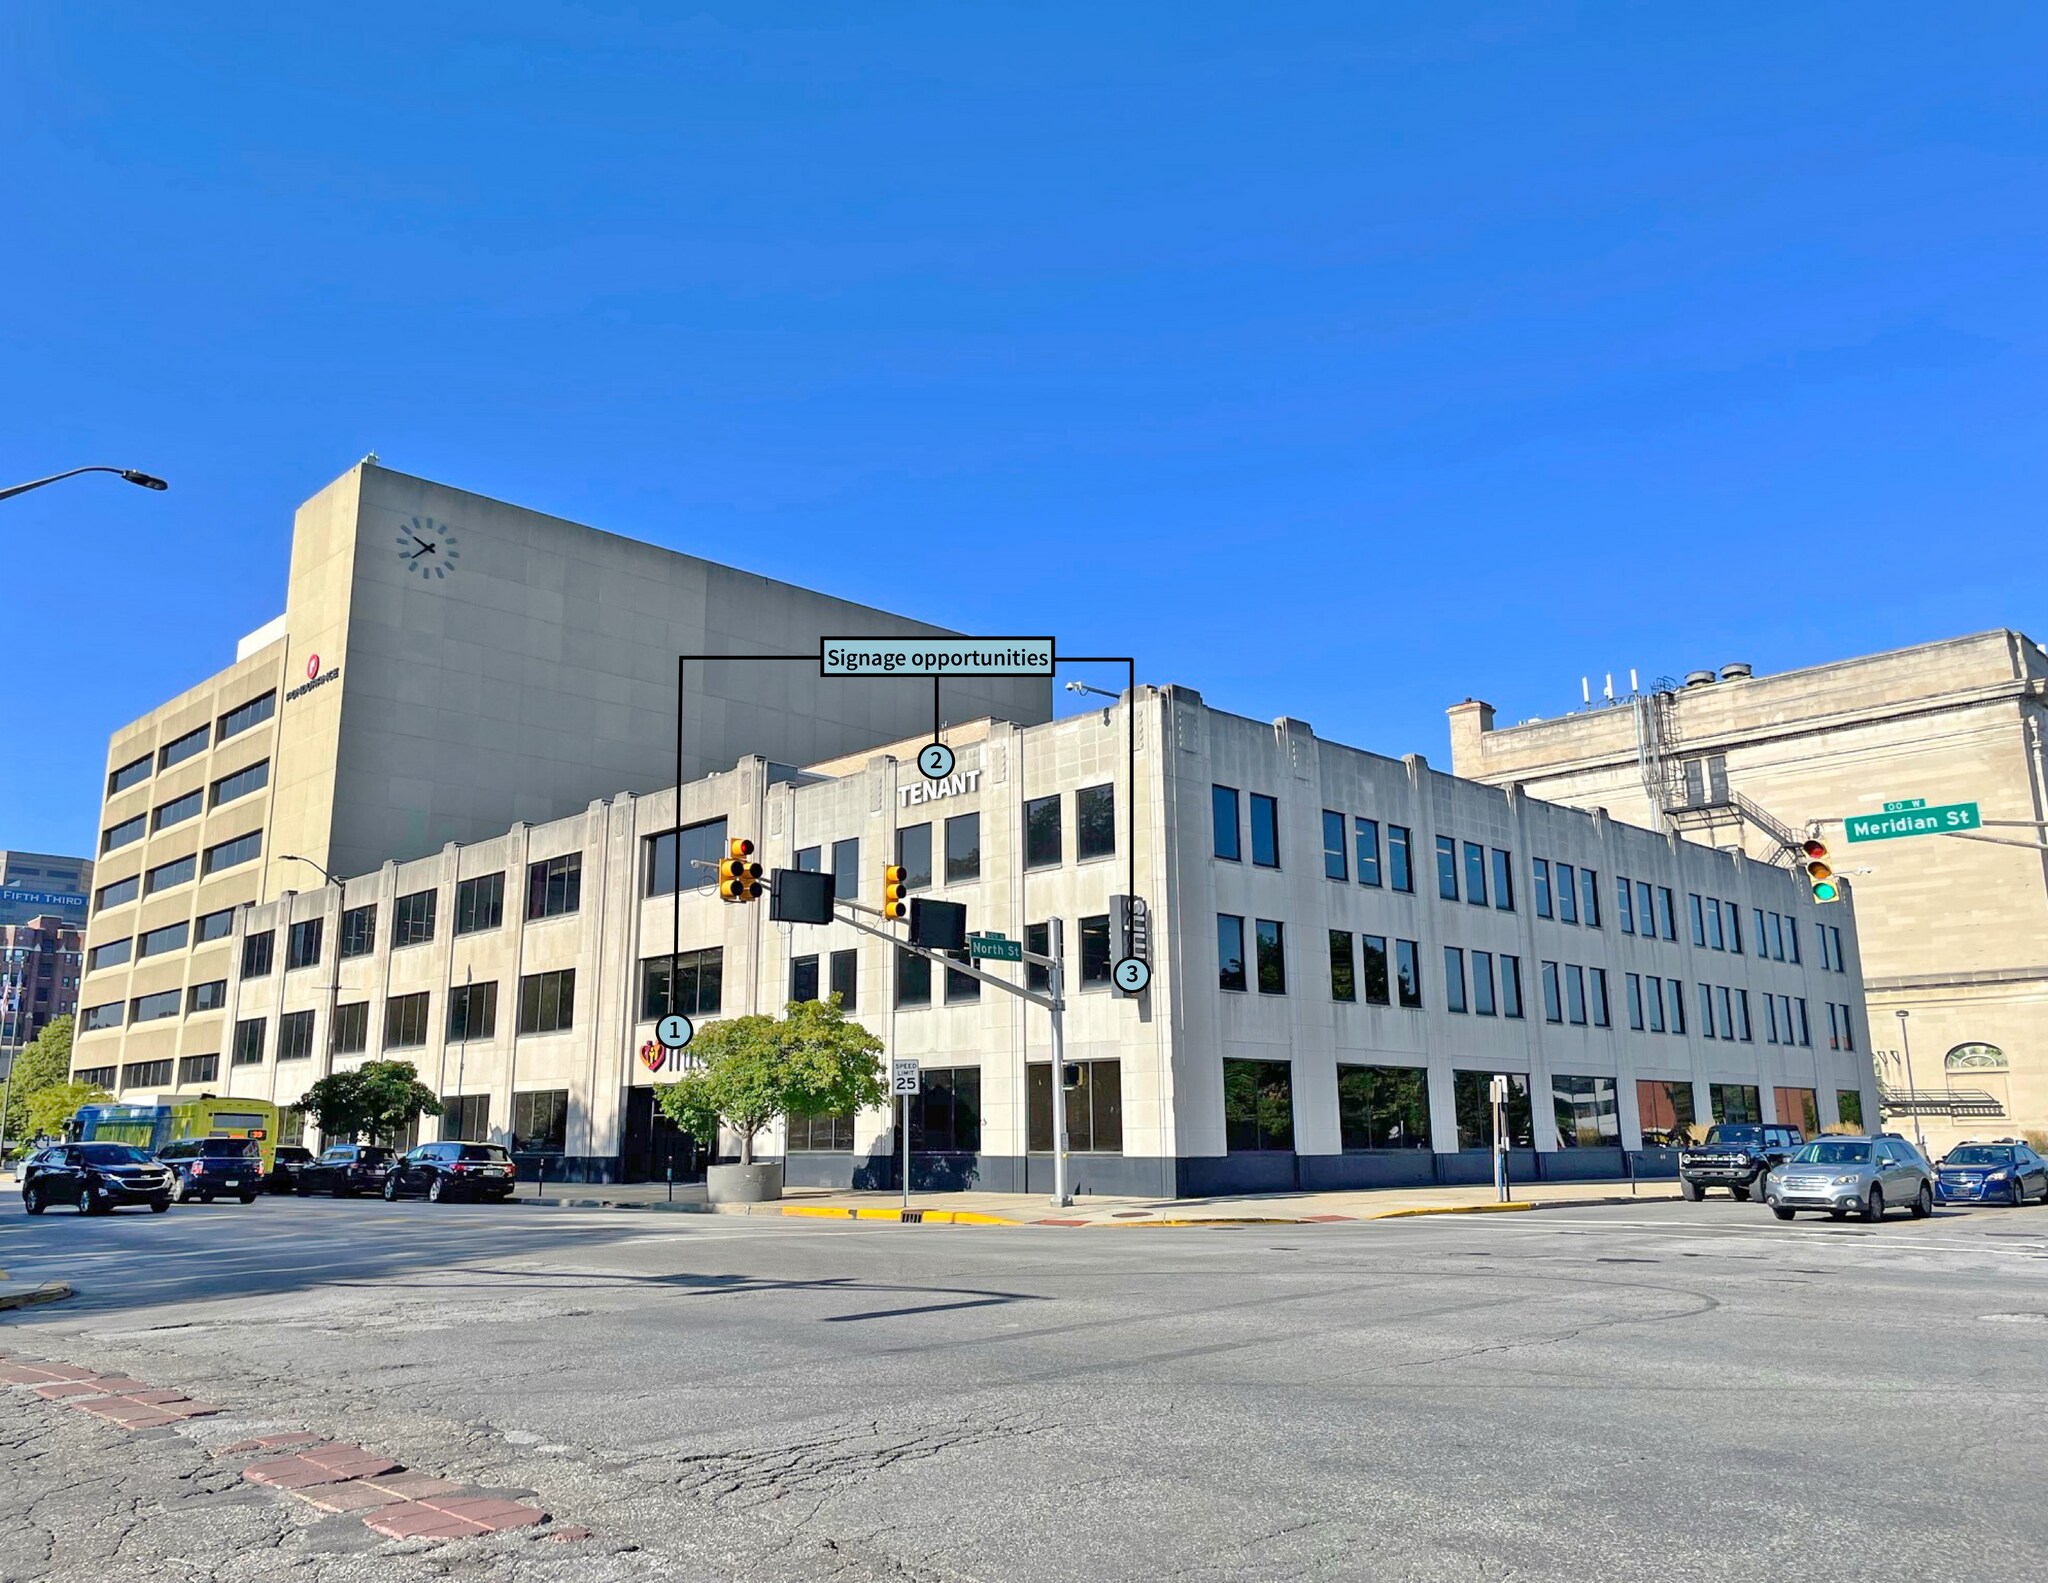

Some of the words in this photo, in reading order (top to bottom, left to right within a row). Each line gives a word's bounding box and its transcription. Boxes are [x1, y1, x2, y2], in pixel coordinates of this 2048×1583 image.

[897, 769, 981, 807] TENANT
[1911, 800, 1920, 808] W
[1853, 816, 1938, 837] Meridian
[1946, 810, 1970, 826] St
[3, 890, 40, 902] FIFTH
[44, 893, 82, 906] THIRD
[973, 941, 1004, 956] North
[1007, 945, 1020, 957] St
[896, 1077, 916, 1090] 25
